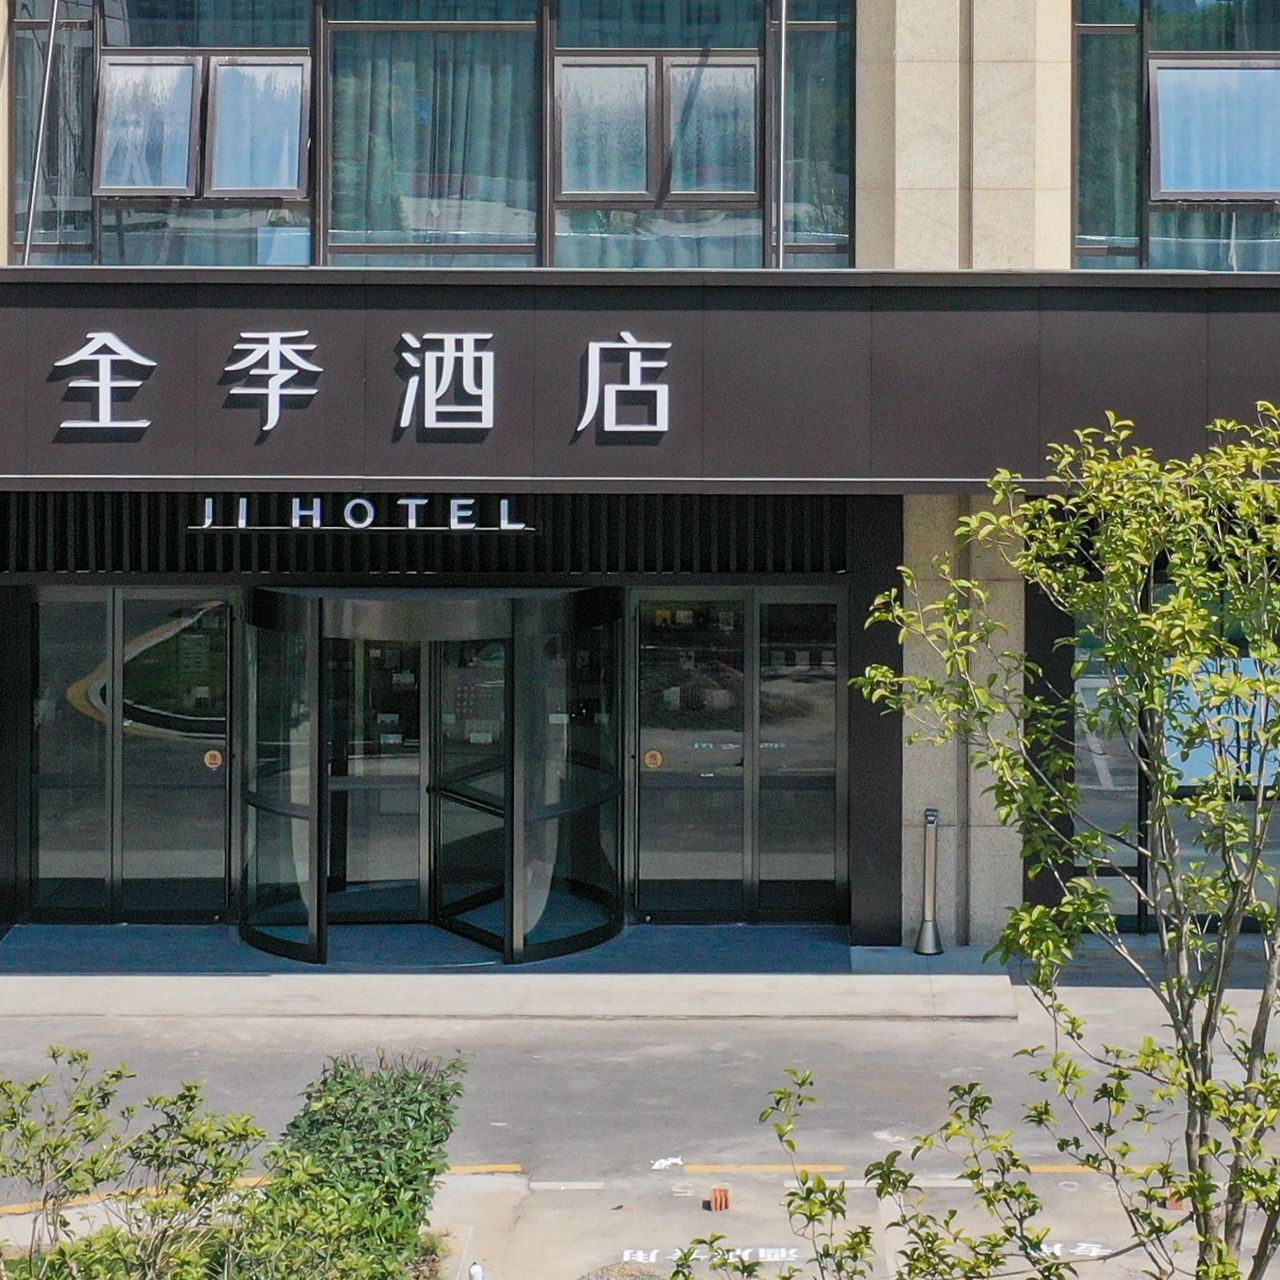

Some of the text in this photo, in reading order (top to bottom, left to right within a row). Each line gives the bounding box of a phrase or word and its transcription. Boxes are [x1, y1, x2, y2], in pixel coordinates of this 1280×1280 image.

[54, 330, 672, 432] 全季酒店
[202, 497, 526, 530] JI HOTEL
